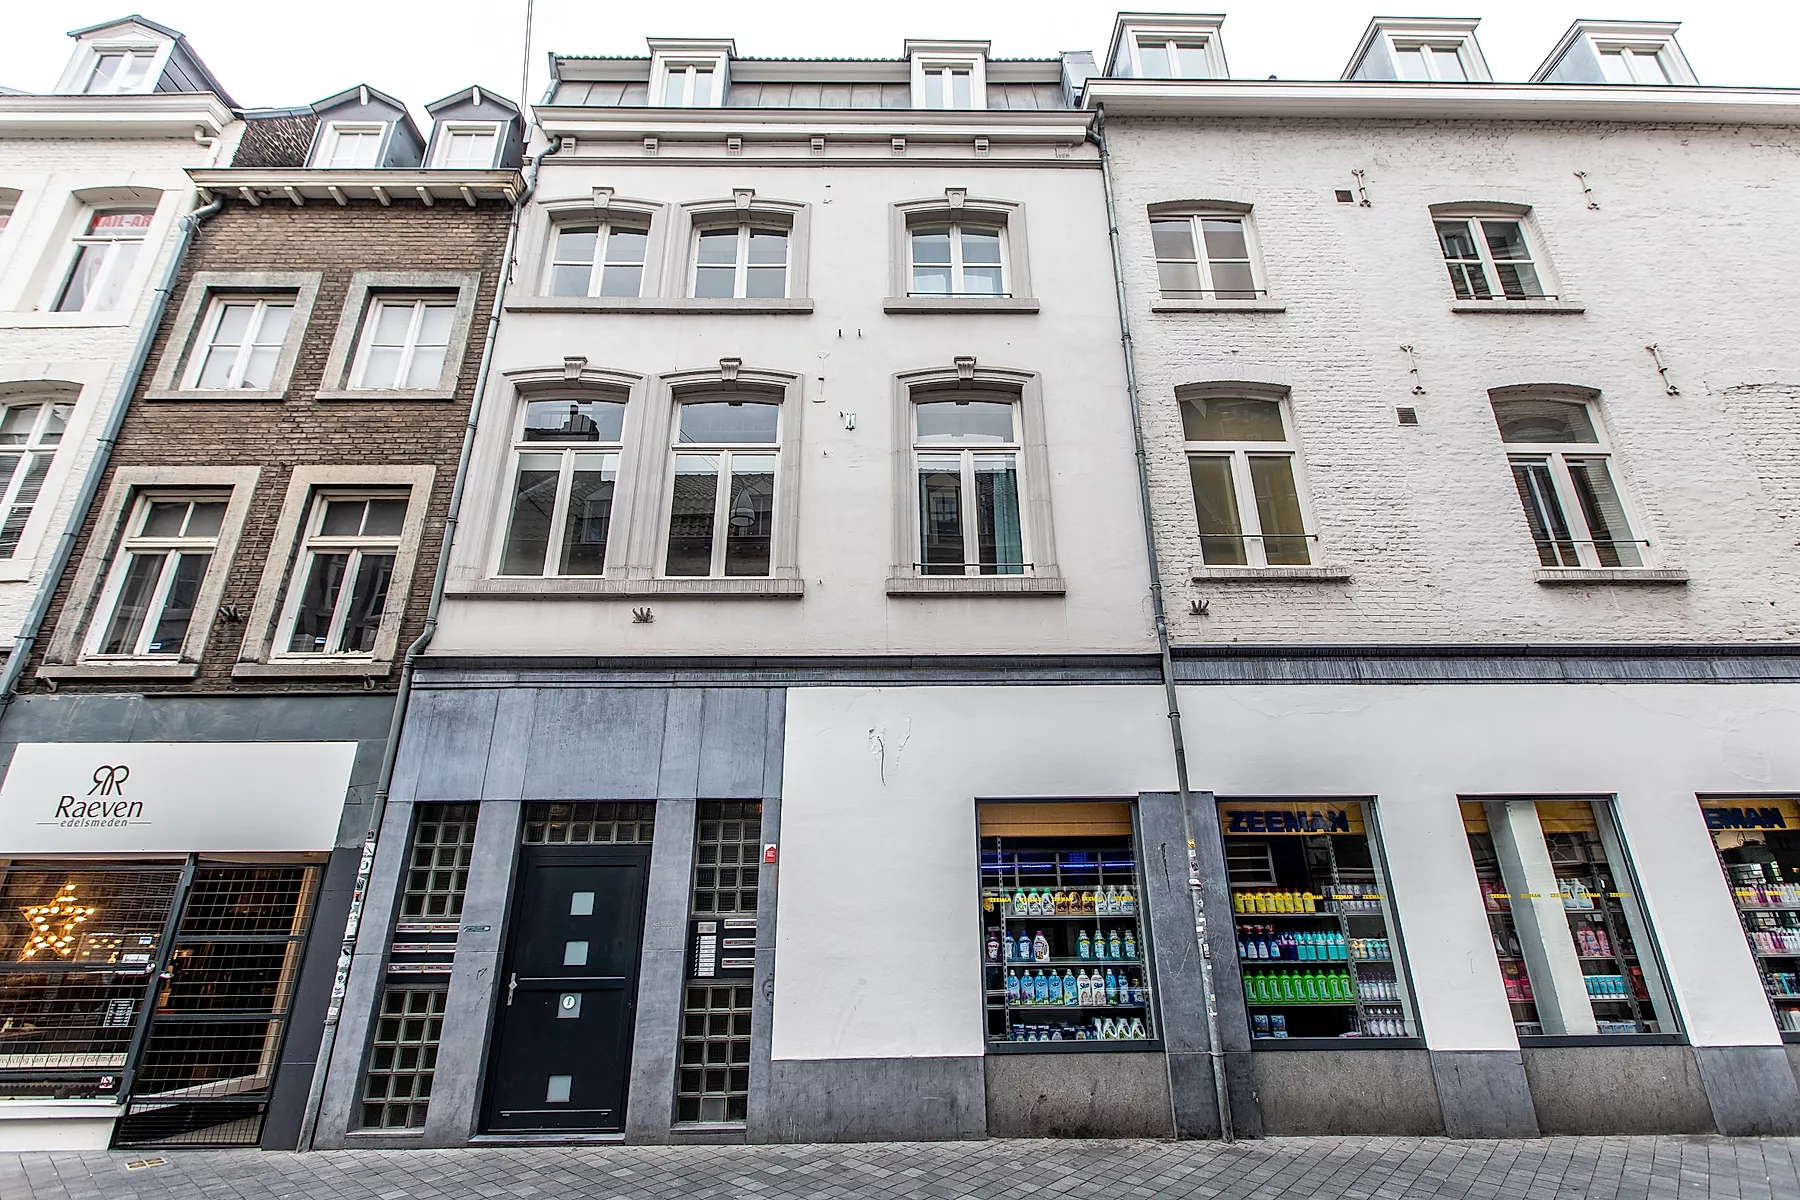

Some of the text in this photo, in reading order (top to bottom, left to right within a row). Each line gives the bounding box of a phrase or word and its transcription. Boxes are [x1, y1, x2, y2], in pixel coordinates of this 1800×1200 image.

[55, 795, 143, 818] Raeven
[60, 818, 128, 828] edelsmeden
[1226, 811, 1350, 833] ZEEMAN
